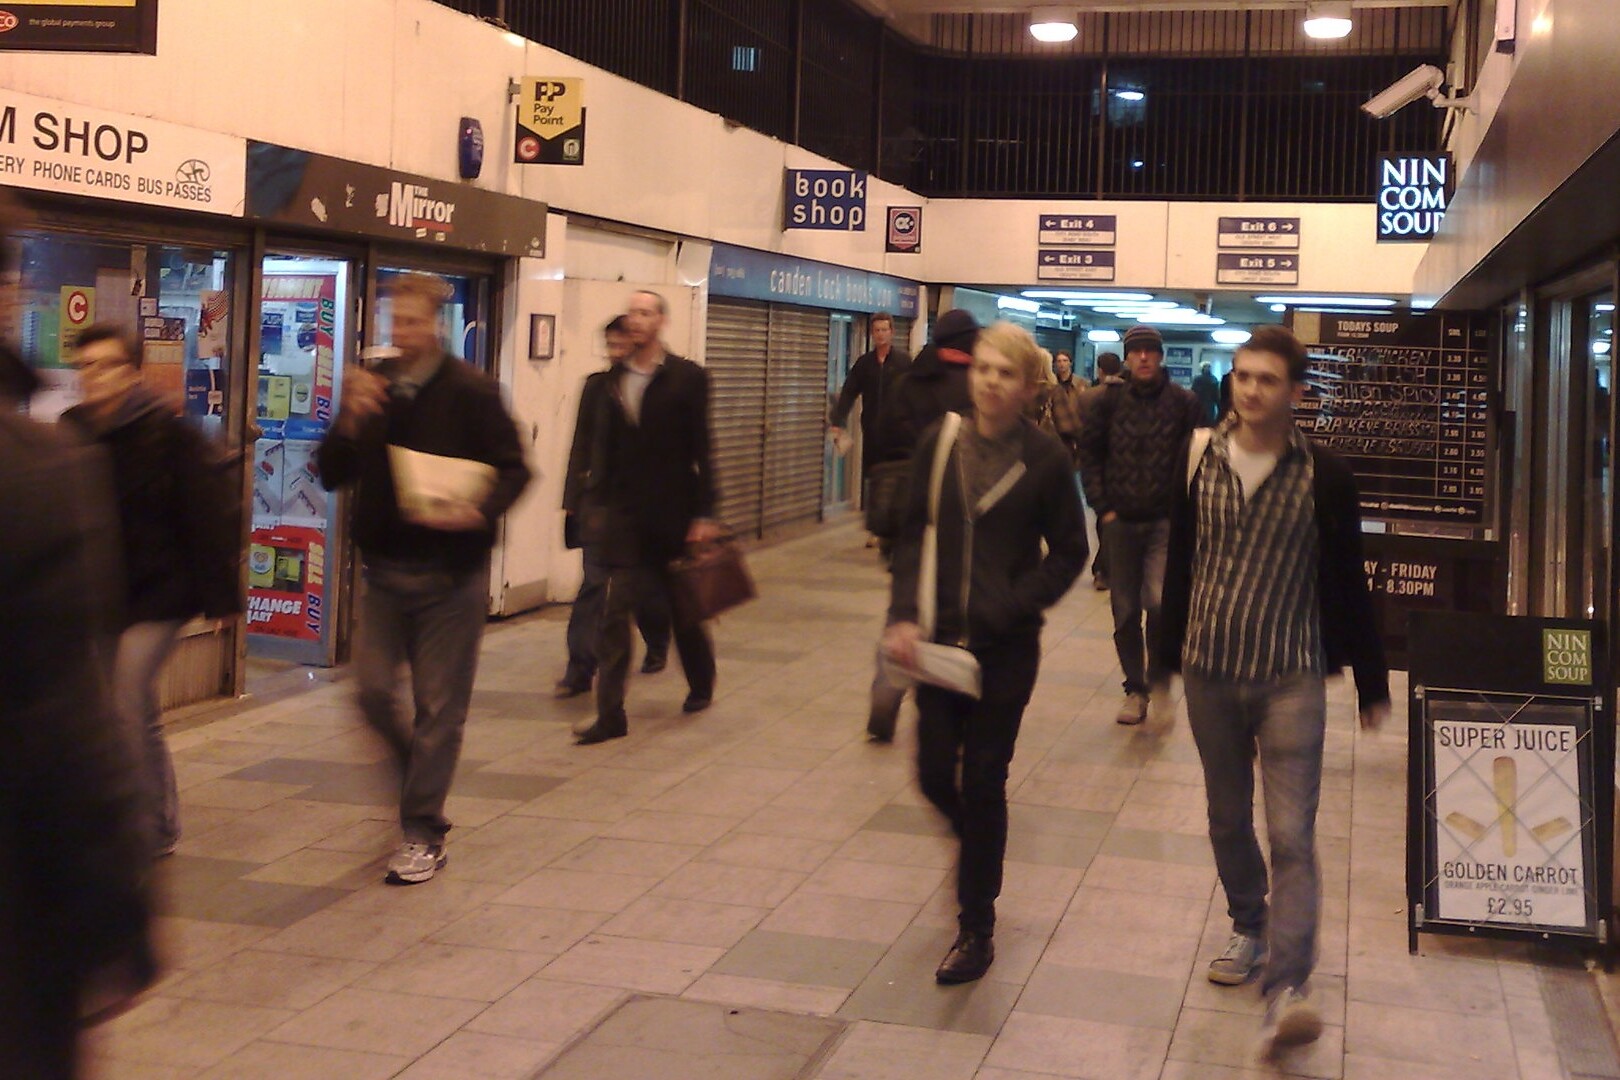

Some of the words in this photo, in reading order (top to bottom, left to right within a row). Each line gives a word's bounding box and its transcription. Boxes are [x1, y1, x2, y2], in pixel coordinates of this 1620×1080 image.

[41, 18, 61, 27] global
[62, 19, 94, 28] payments
[95, 20, 115, 28] group
[534, 103, 554, 116] Pay
[533, 115, 563, 125] Point
[32, 112, 148, 164] SHOP
[1381, 158, 1447, 186] NIN
[33, 160, 82, 183] PHONE
[85, 168, 131, 190] CARDS
[137, 177, 163, 195] BUS
[166, 181, 212, 203] PASSES
[795, 171, 864, 199] book
[389, 181, 456, 228] Mirror
[1380, 186, 1446, 210] COM
[793, 199, 863, 231] shop
[1060, 219, 1082, 229] Exit
[1085, 219, 1094, 229] 4
[1241, 221, 1264, 231] Exit
[1267, 221, 1277, 231] 6
[1059, 254, 1081, 264] Exit
[1084, 254, 1093, 264] 3
[1240, 258, 1263, 268] Exit
[1267, 258, 1275, 268] 5
[770, 265, 811, 296] camden
[321, 298, 335, 336] BUY
[1338, 321, 1372, 332] TODAYS
[1373, 322, 1398, 333] SOUP
[316, 395, 331, 421] BU
[1391, 563, 1437, 579] FRIDAY
[1386, 579, 1434, 596] 8.30PM
[248, 596, 302, 614] HANGE
[308, 592, 321, 634] BUY
[1548, 634, 1586, 650] NIN
[1547, 650, 1587, 665] COM
[1548, 666, 1588, 680] SOUP
[1439, 726, 1506, 749] SUPER
[1514, 730, 1570, 752] JUICE
[1444, 861, 1507, 881] GOLDEN
[1513, 865, 1577, 885] CARROT
[1487, 897, 1533, 916] £2.95
